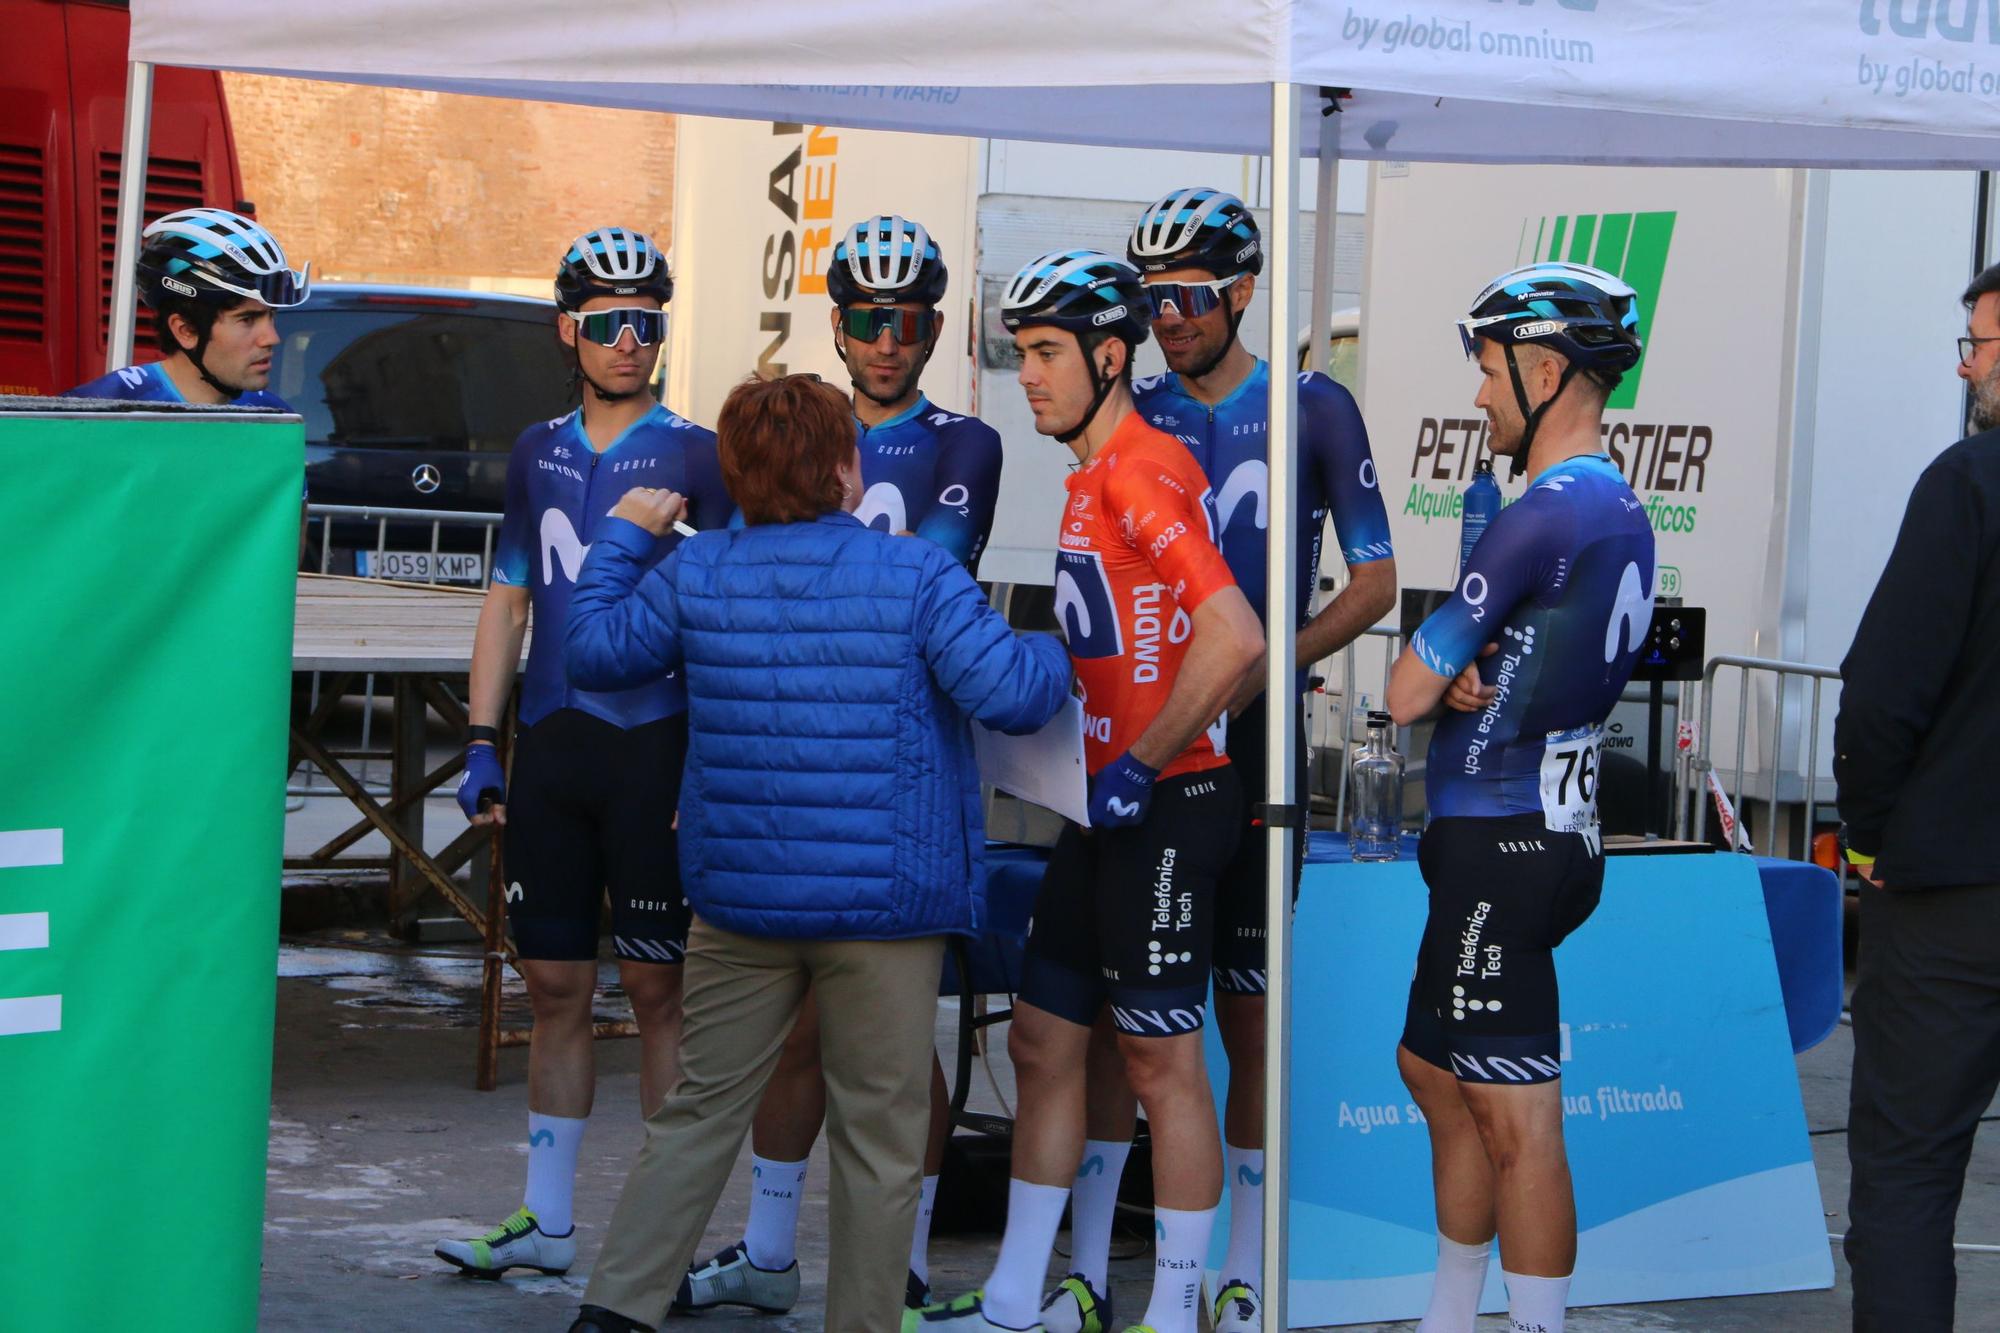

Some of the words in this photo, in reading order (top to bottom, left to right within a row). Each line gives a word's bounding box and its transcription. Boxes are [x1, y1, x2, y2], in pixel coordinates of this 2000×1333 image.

[1341, 7, 1379, 51] by
[1382, 14, 1471, 54] global
[1479, 28, 1594, 64] omnium
[1858, 53, 1888, 95] by
[1895, 58, 1975, 98] global
[1519, 325, 1551, 337] ABUS
[1233, 422, 1266, 436] GOBI
[1411, 417, 1497, 482] PETI
[1403, 483, 1464, 525] Alquile
[1151, 521, 1187, 558] 2023
[436, 556, 476, 577] KMP
[1477, 653, 1521, 734] Telefónica
[1464, 738, 1489, 775] Tech
[1498, 840, 1546, 853] GOBIK
[630, 898, 668, 912] GOBIK
[1152, 847, 1177, 932] Telefónica
[1176, 891, 1192, 932] Tech
[1457, 900, 1492, 977] Telefónica
[1481, 944, 1502, 980] Tech
[1338, 1102, 1400, 1134] Agua
[1596, 1084, 1684, 1121] filtrada
